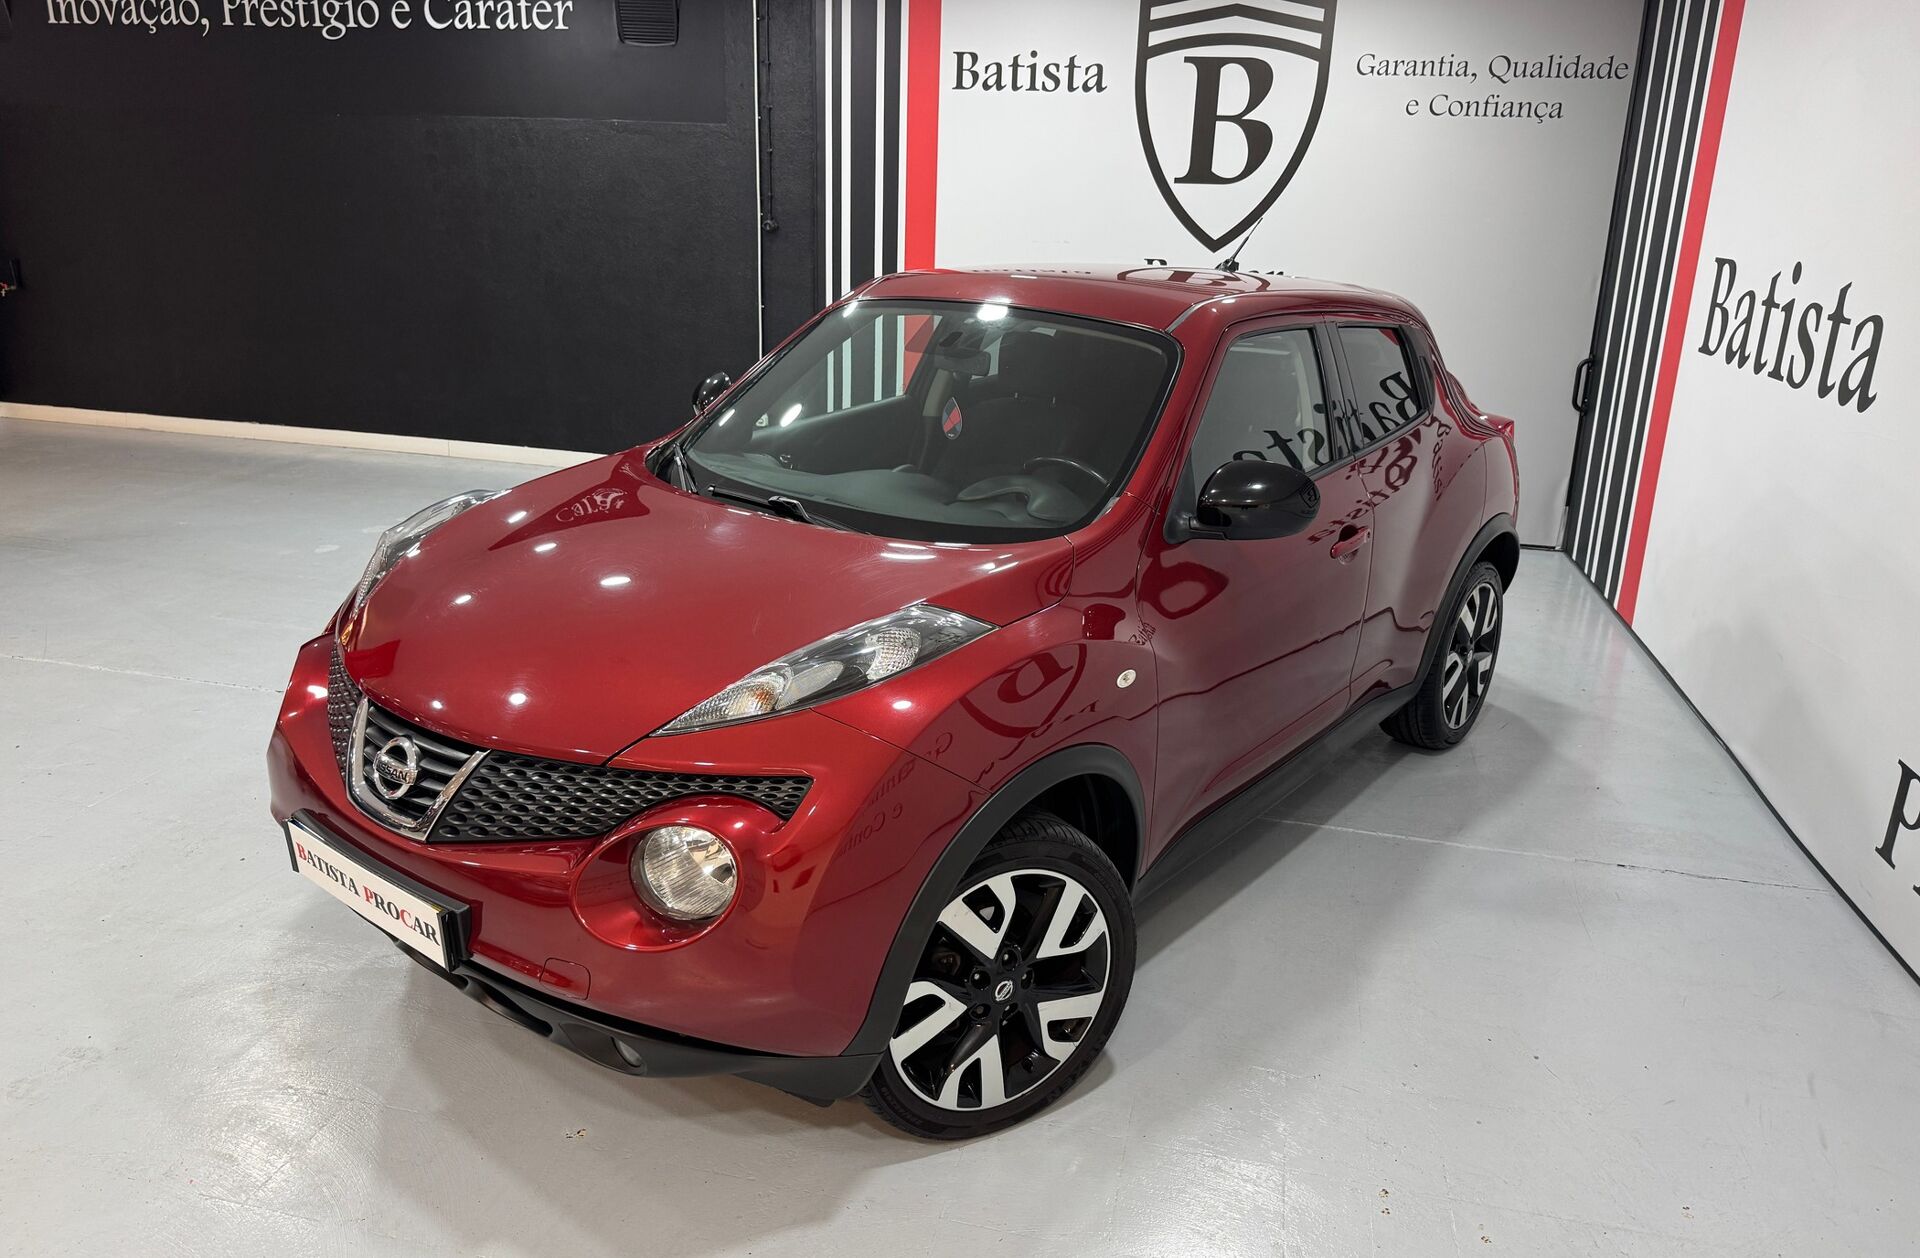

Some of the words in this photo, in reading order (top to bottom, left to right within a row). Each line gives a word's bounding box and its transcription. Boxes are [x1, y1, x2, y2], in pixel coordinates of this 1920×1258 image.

[390, 0, 412, 29] e
[951, 49, 1108, 93] Batista
[1355, 53, 1478, 84] Garantia,
[1488, 54, 1630, 84] Qualidade
[1173, 55, 1275, 185] B
[1405, 98, 1420, 117] e
[1428, 94, 1564, 124] Confiança
[1698, 256, 1885, 413] Batista
[295, 841, 361, 898] BATISTA
[362, 884, 441, 947] PROCAR
